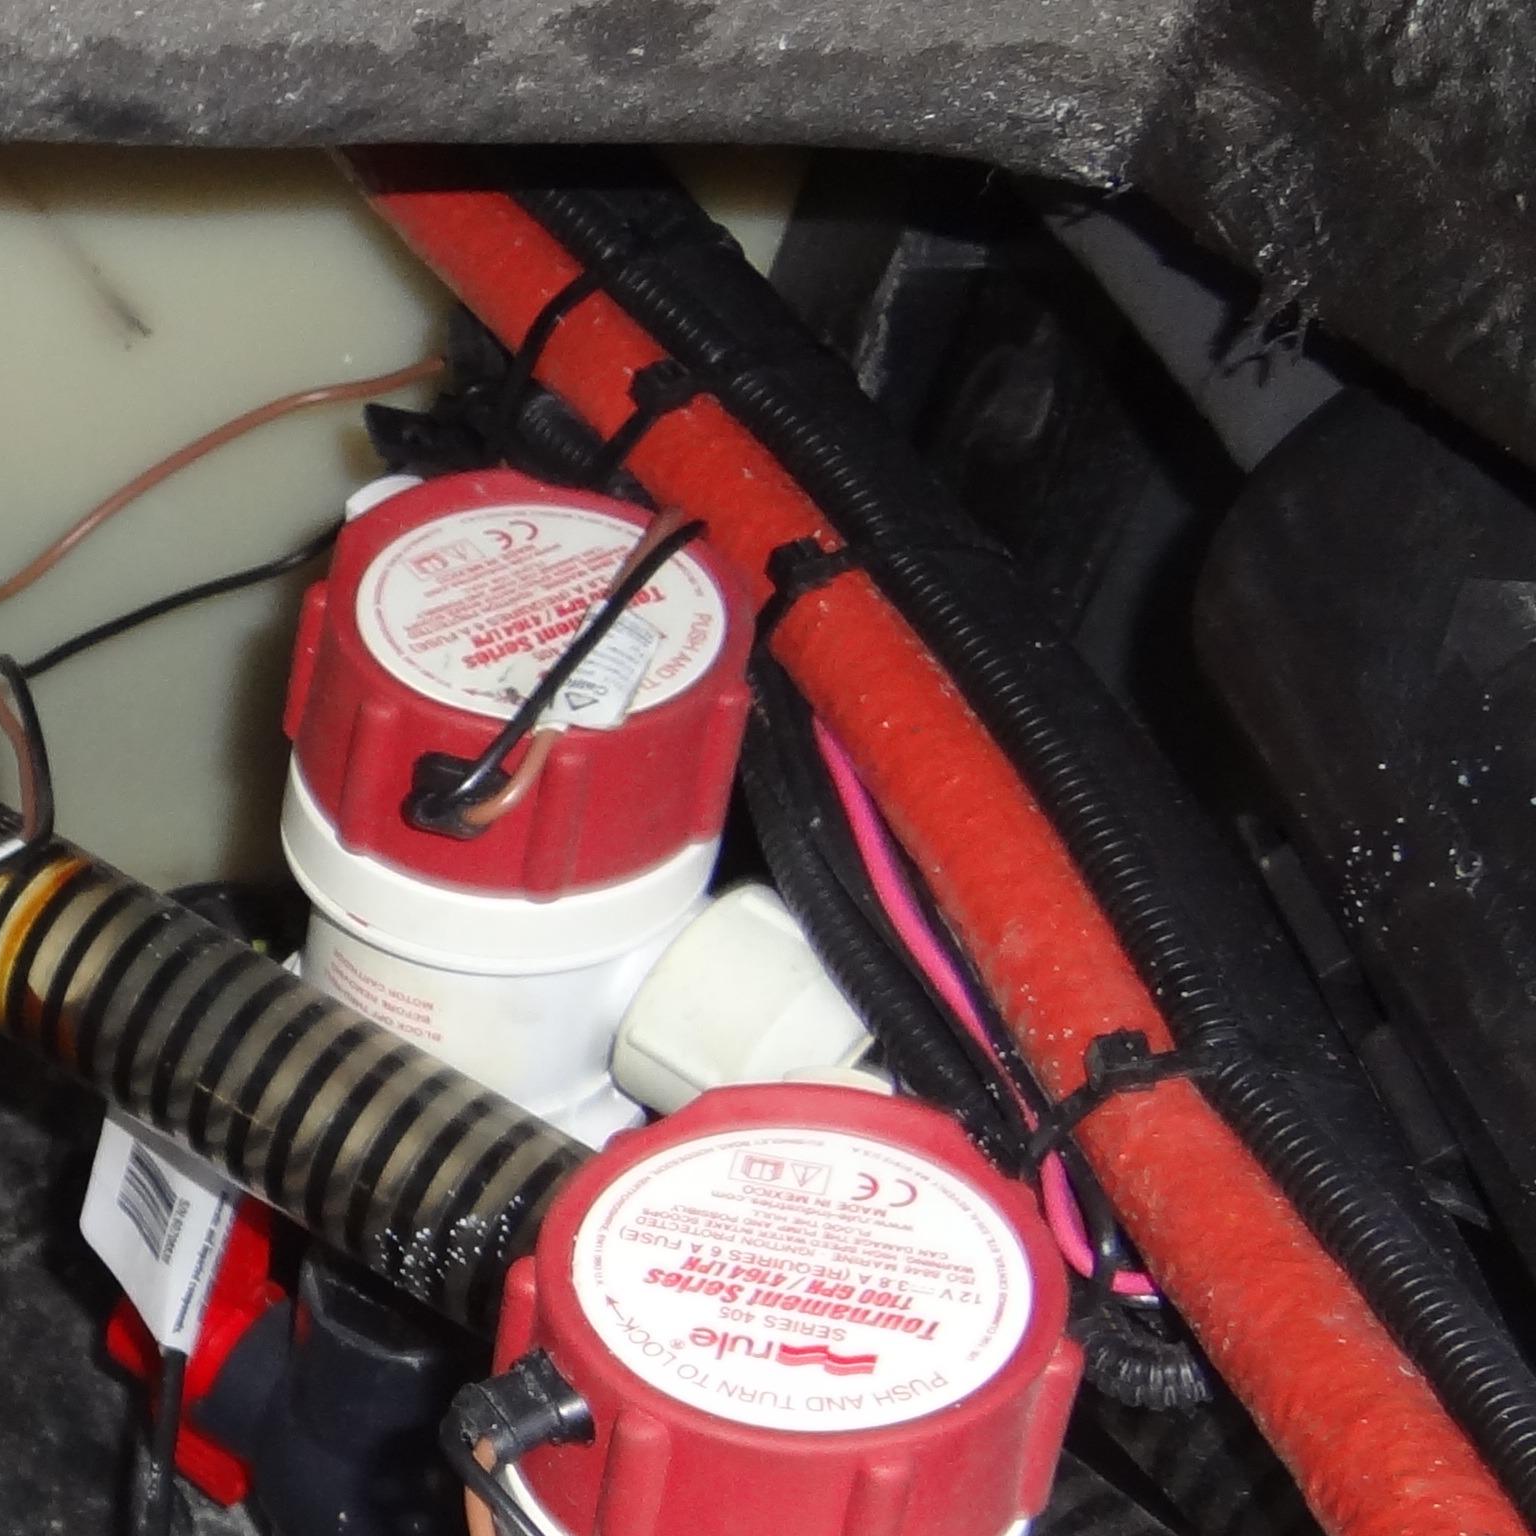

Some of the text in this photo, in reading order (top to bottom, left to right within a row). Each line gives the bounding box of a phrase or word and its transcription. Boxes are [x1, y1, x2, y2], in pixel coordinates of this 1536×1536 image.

[461, 636, 534, 671] Series
[656, 613, 713, 681] PUSH AND
[743, 1185, 887, 1217] MADE IN MEXICO
[636, 1216, 736, 1242] PROTECTED
[741, 1236, 815, 1257] IGNITION
[619, 1226, 981, 1305] 12 V 3.8 A (REQUIRES 6 A FUSE)
[680, 1256, 727, 1277] LPH
[728, 1265, 787, 1287] 4164
[832, 1253, 898, 1271] MARINE
[804, 1280, 856, 1300] GPH
[947, 1273, 976, 1285] ISO
[642, 1268, 940, 1340] Tournament Series
[858, 1289, 913, 1310] 1100
[719, 1307, 847, 1342] SERIES 405
[689, 1328, 773, 1361] rule
[616, 1316, 949, 1412] PUSH AND TURN TO LOCK
